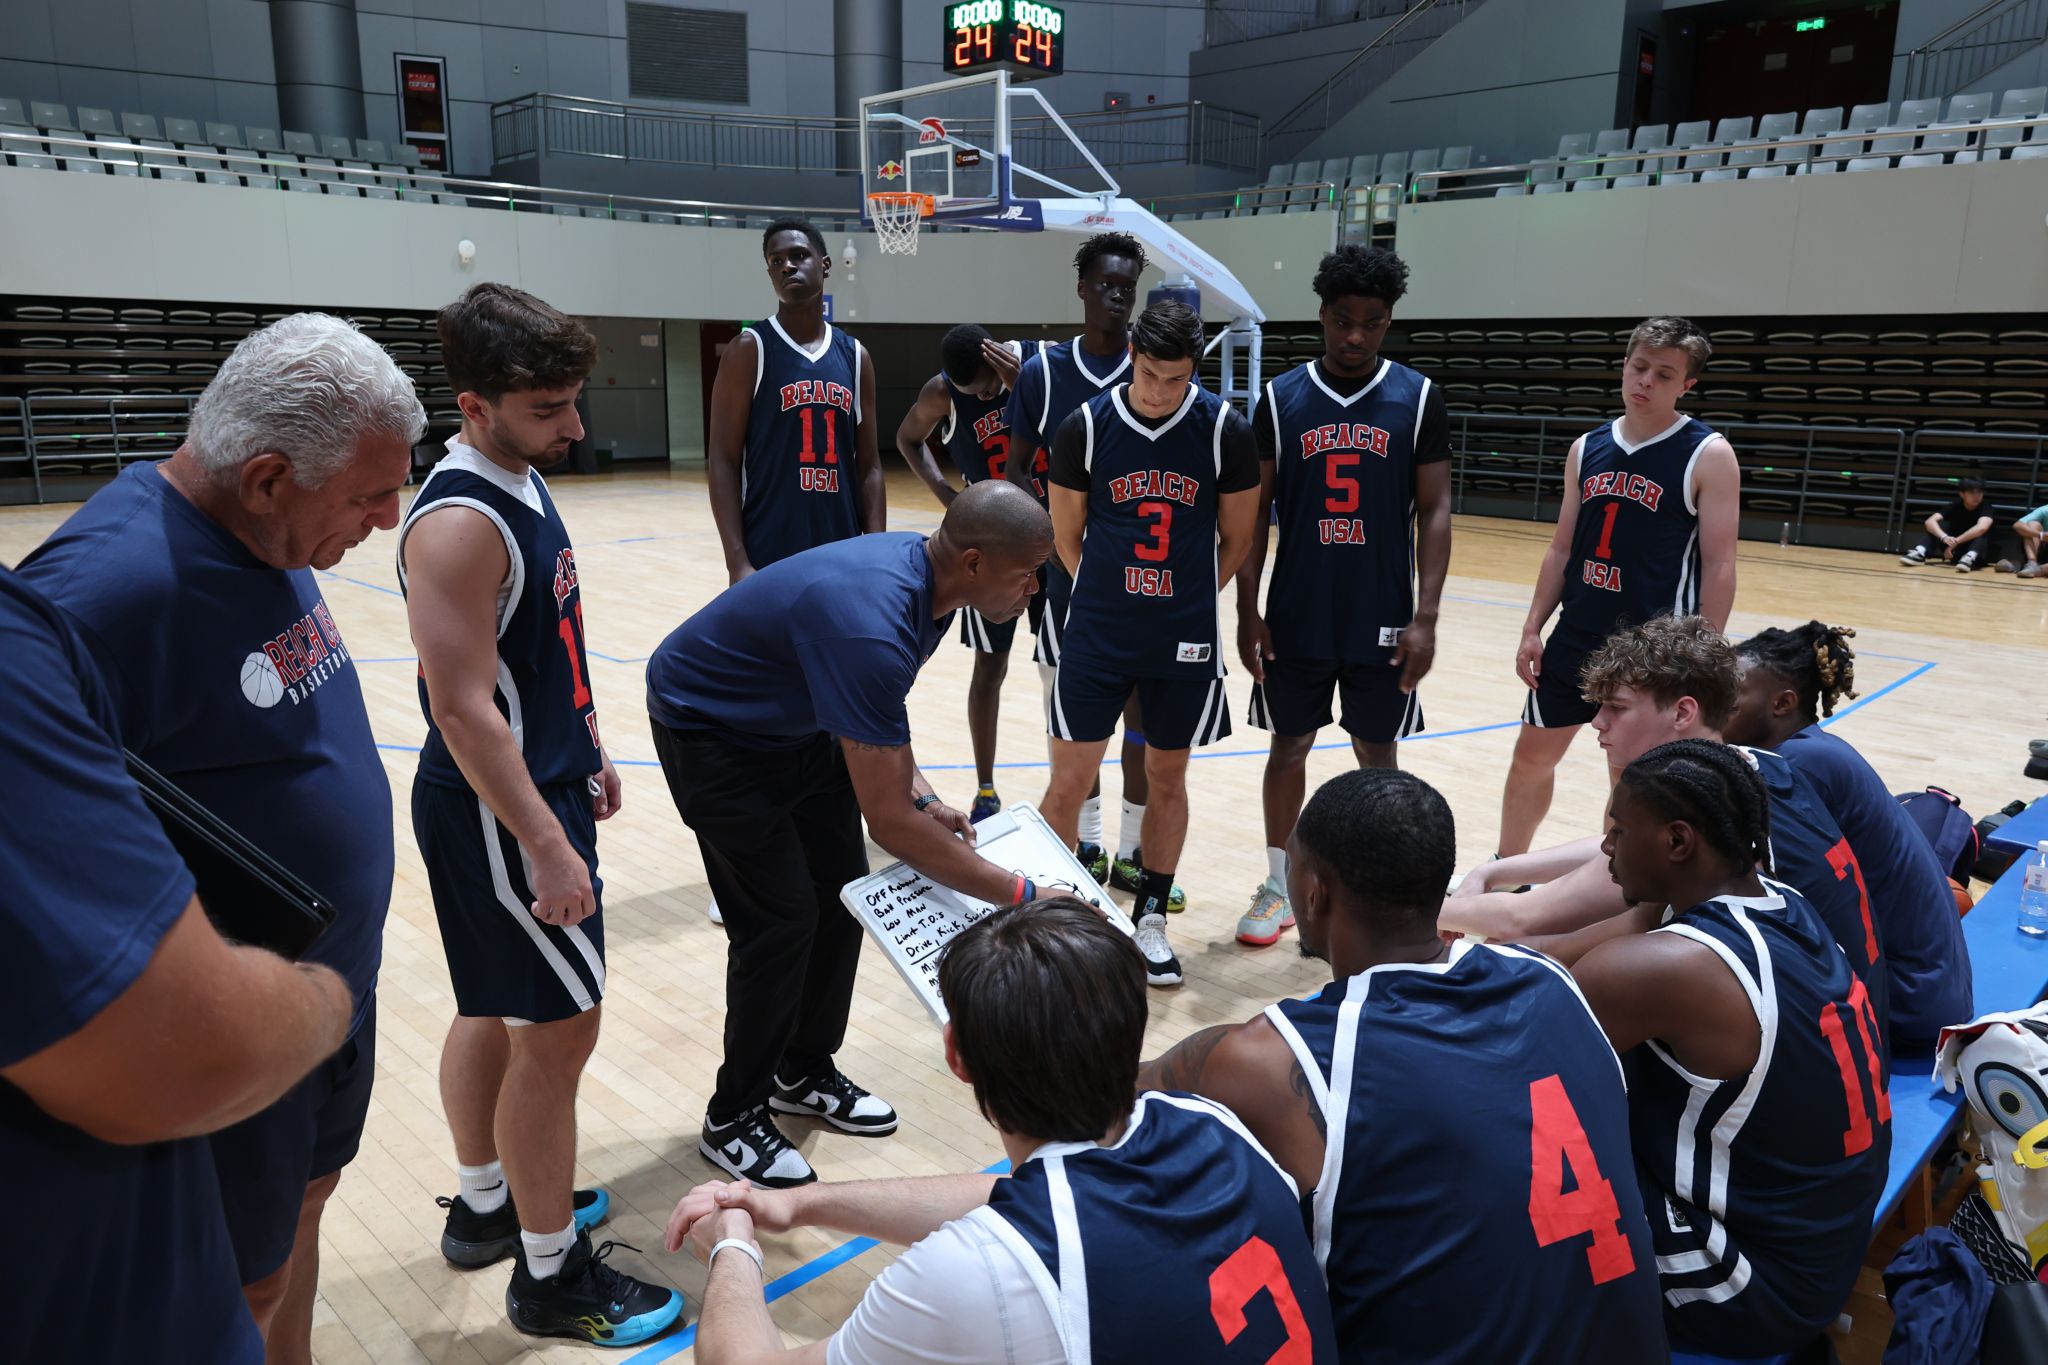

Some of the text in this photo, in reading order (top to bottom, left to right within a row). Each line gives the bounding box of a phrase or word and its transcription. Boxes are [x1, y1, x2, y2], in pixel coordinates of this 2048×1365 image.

[955, 24, 992, 66] 24
[1015, 23, 1052, 67] 24
[780, 380, 853, 416] REACH
[799, 407, 838, 464] 11
[1301, 422, 1390, 460] REACH
[799, 467, 839, 493] USA
[1109, 470, 1200, 507] REACH
[1325, 454, 1360, 513] 5
[1581, 471, 1664, 513] REACH
[1134, 501, 1173, 562] 3
[1318, 518, 1366, 545] USA
[1594, 501, 1620, 560] 1
[1125, 566, 1174, 597] USA
[1582, 559, 1622, 593] USA
[262, 614, 329, 689] REACH
[896, 885, 933, 906] Pressure
[882, 918, 901, 932] Low
[1529, 1073, 1637, 1286] 4
